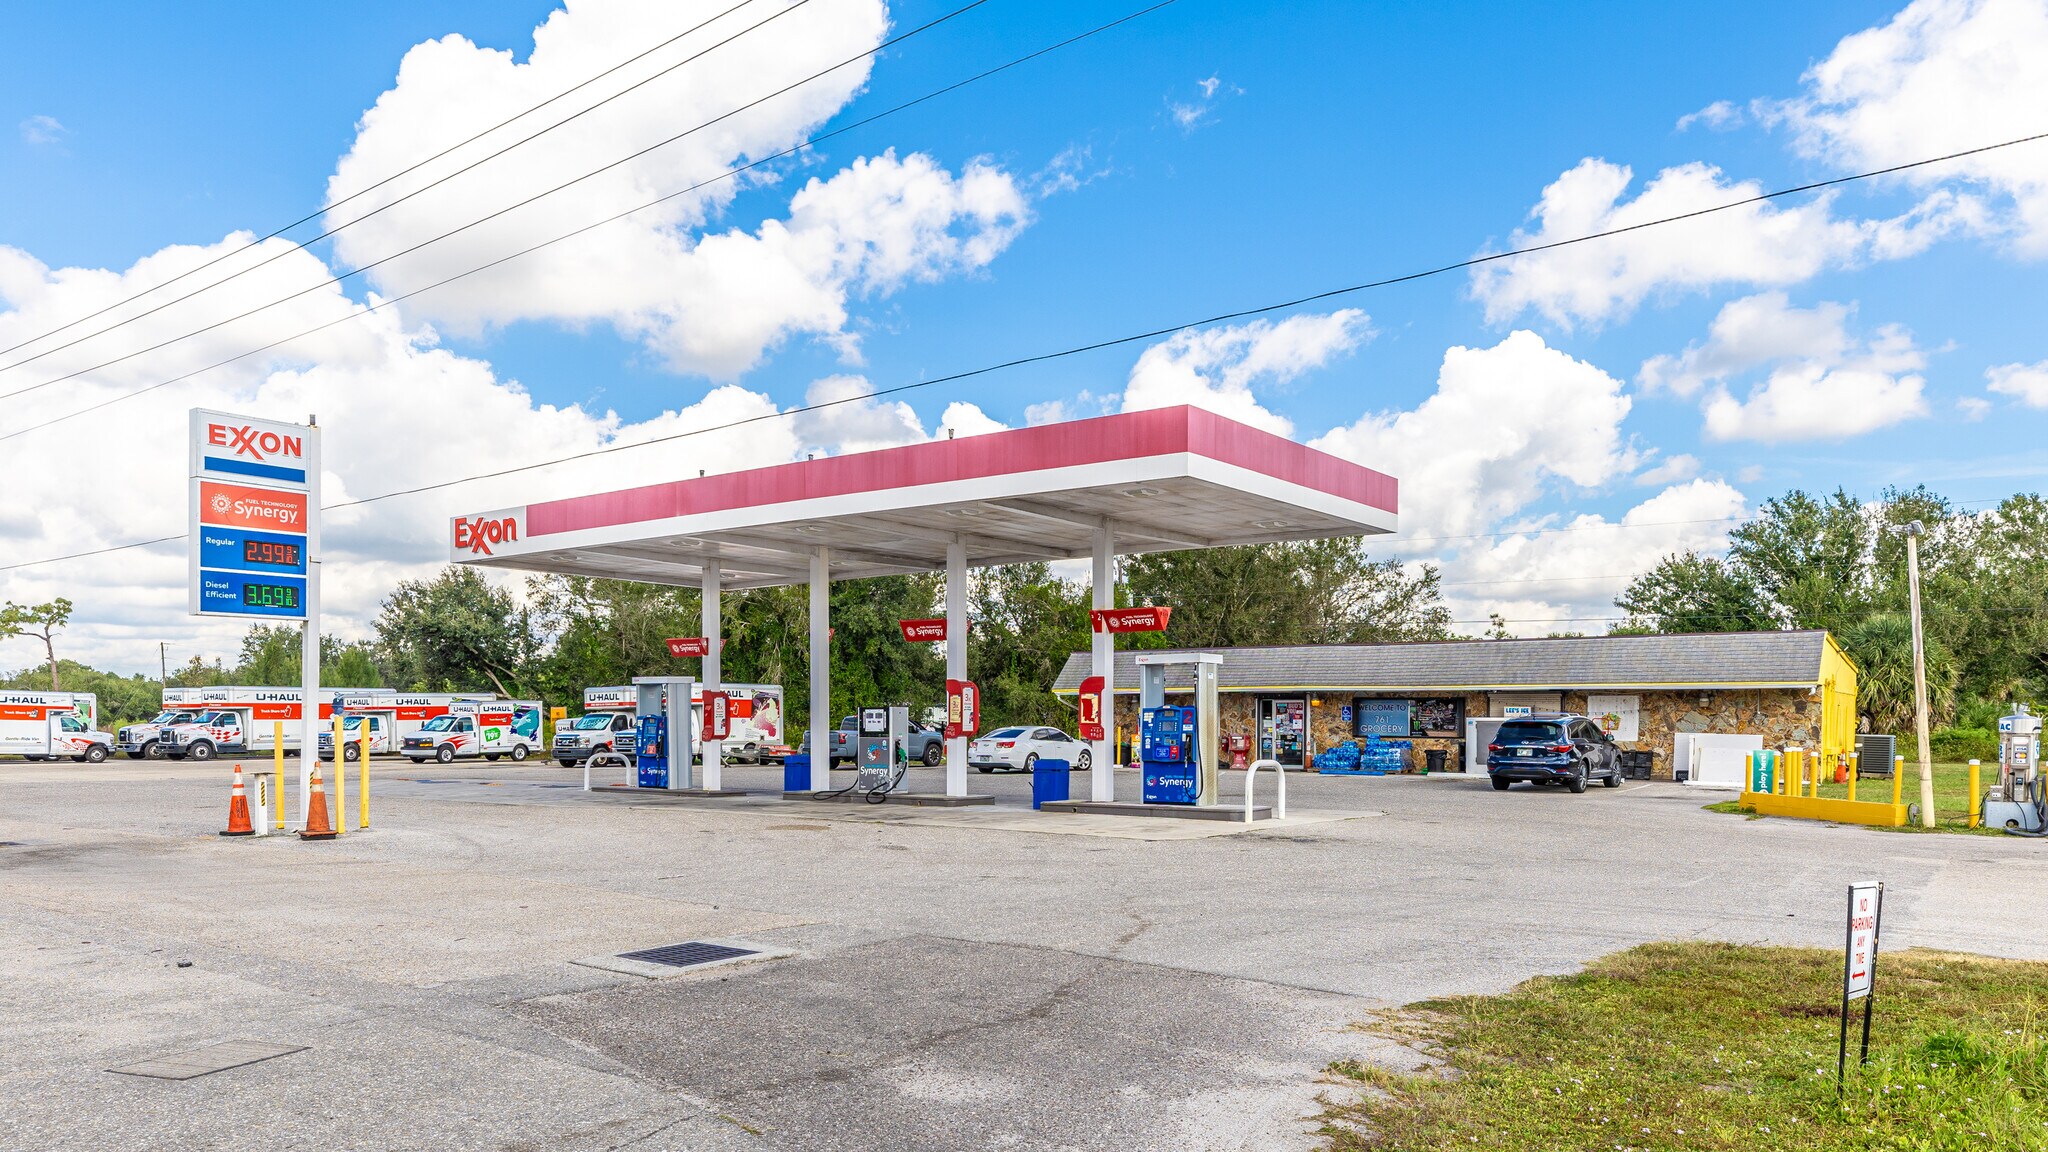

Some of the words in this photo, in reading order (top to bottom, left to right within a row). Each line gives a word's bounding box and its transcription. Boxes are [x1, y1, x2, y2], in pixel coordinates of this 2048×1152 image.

[208, 423, 302, 461] EXXON
[261, 500, 298, 509] TECHNOLOGY
[234, 501, 298, 524] Synergy
[205, 536, 236, 547] Regular
[455, 517, 518, 556] Exxon
[205, 580, 229, 590] Diesel
[205, 590, 237, 600] Efficient
[1121, 617, 1155, 627] Synergy
[916, 627, 943, 637] Synergy
[164, 693, 182, 701] U-HAUL
[203, 693, 227, 701] U-HAUL
[256, 693, 302, 701] U-HAUL
[589, 693, 620, 701] U-HAUL
[1360, 704, 1394, 712] WELCOME
[1397, 704, 1406, 712] TO
[1183, 710, 1193, 724] 2
[1374, 715, 1389, 723] 761
[1360, 724, 1403, 733] GROCERY
[860, 766, 888, 777] Synergy
[1759, 772, 1768, 789] play
[1860, 898, 1868, 912] NO
[1852, 915, 1873, 932] PARKING
[1857, 935, 1866, 948] ANY
[1856, 952, 1865, 965] TIME
